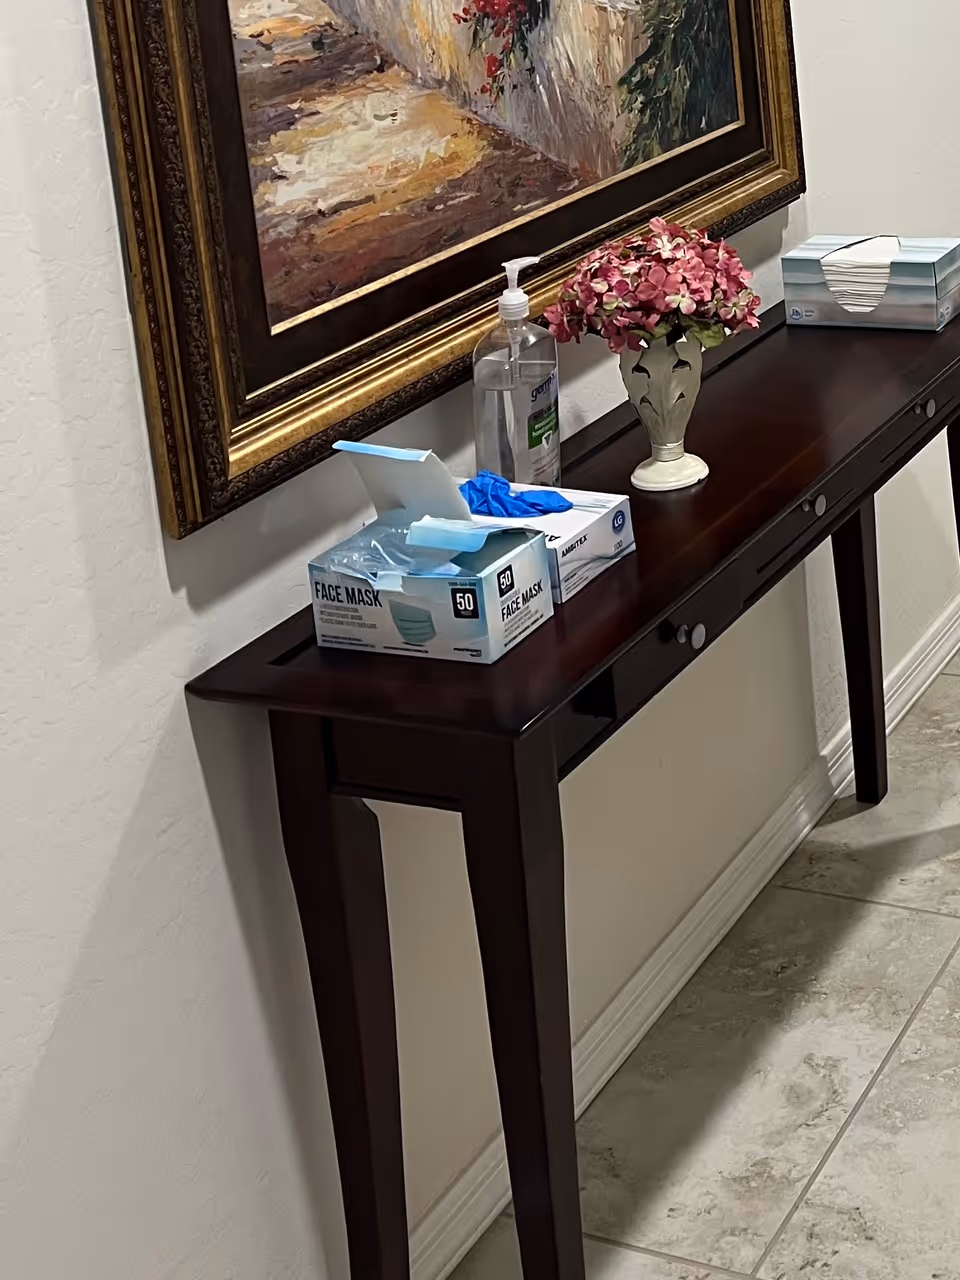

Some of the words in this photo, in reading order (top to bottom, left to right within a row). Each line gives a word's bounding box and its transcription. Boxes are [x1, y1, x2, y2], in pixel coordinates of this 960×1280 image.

[614, 516, 623, 527] LG
[562, 533, 588, 558] AMBITEX
[500, 570, 512, 589] 50
[314, 581, 344, 603] FACE
[345, 586, 383, 608] MASK
[456, 593, 474, 610] 50
[501, 596, 522, 622] FACE
[521, 579, 543, 606] MASK
